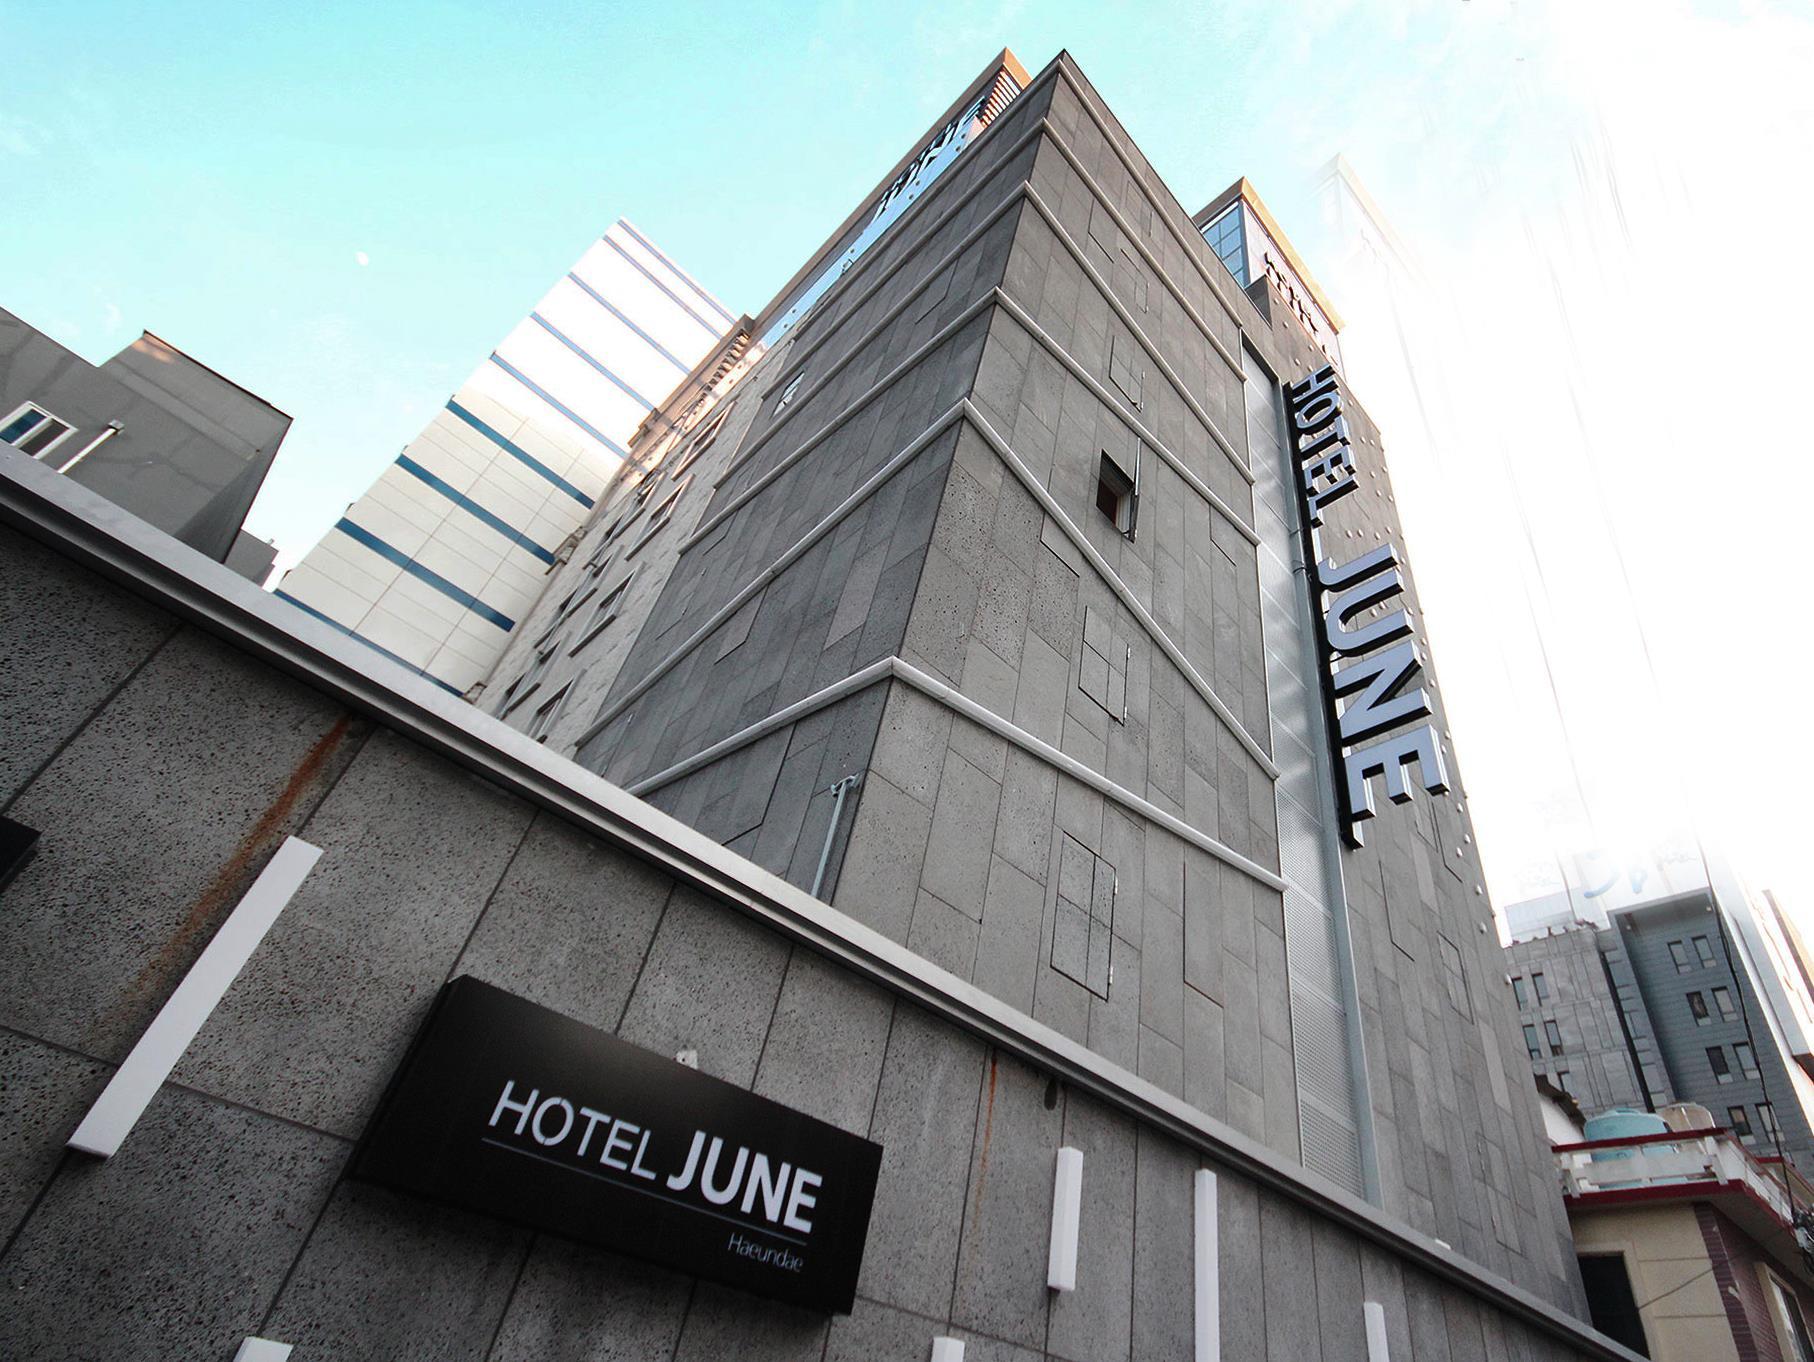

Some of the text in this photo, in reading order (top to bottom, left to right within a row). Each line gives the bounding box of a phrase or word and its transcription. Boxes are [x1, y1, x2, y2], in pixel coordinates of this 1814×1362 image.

[1291, 363, 1360, 528] HOTEL
[1317, 543, 1451, 822] JUNE
[488, 1079, 823, 1234] HOTEL JUNE
[727, 1232, 804, 1273] Haeundae
